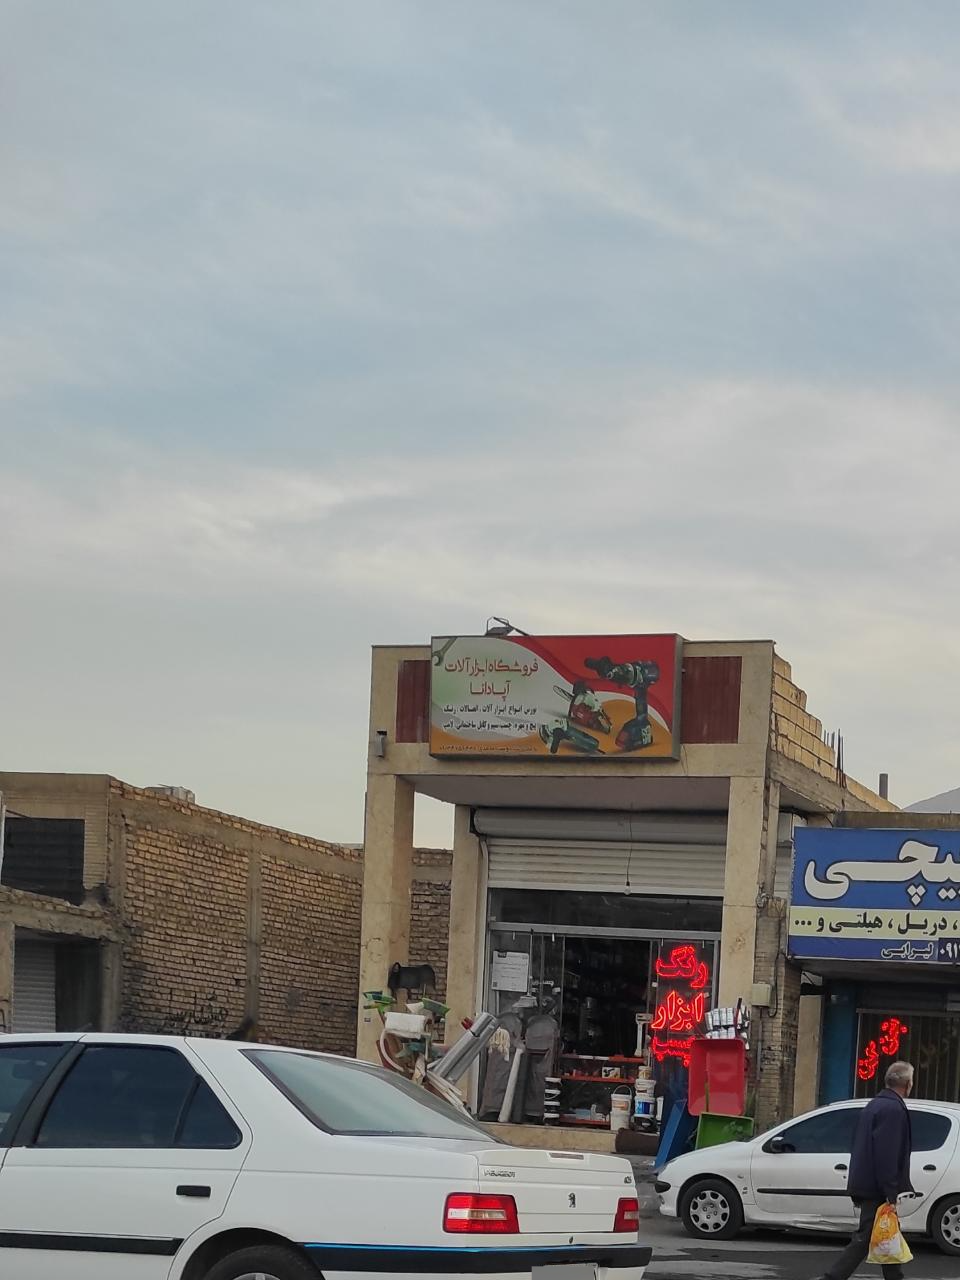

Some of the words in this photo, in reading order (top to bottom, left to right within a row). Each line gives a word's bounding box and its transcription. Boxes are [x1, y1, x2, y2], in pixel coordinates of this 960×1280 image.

[489, 659, 539, 677] فروشگاه
[816, 915, 825, 932] و
[828, 911, 883, 934] هیلتی
[897, 912, 948, 936] دریل
[656, 944, 709, 989] رنگ
[651, 991, 706, 1030] ابزار
